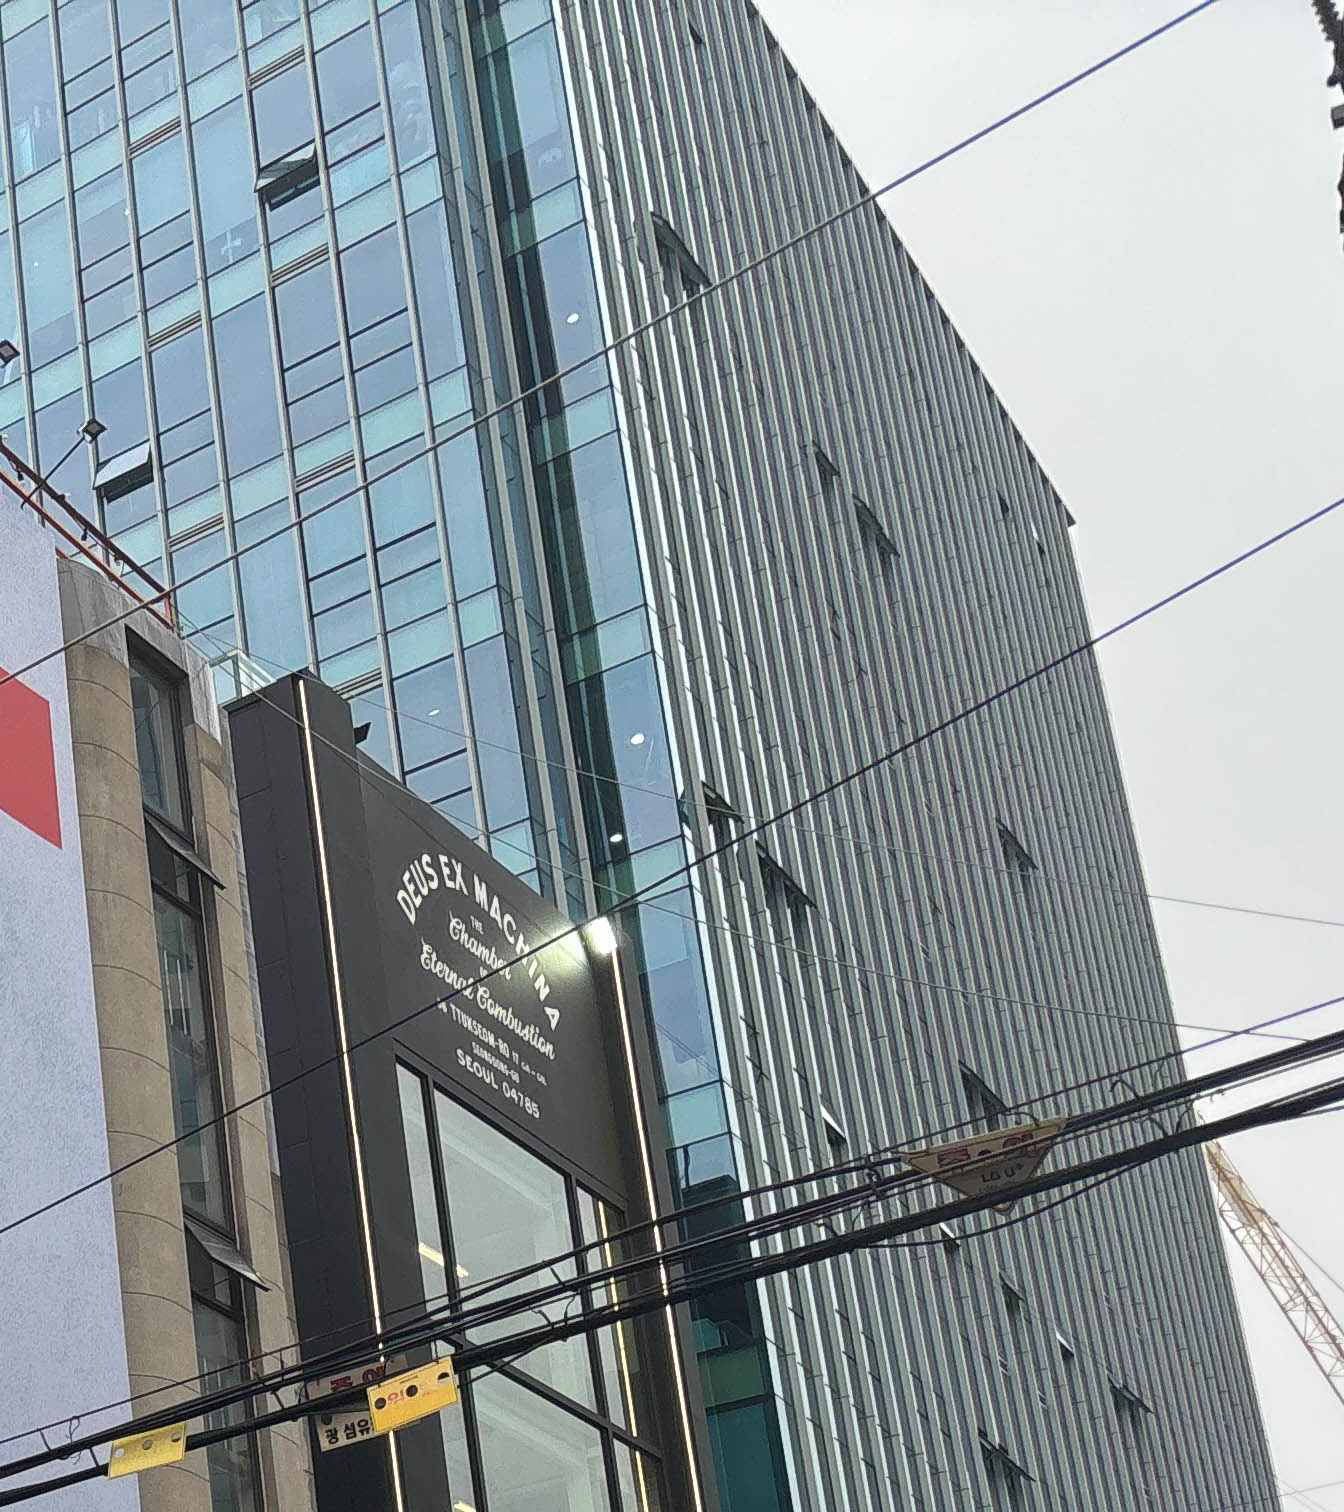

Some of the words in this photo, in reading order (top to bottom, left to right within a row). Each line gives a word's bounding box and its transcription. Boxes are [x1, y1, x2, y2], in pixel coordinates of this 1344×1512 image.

[396, 854, 438, 925] DEUS
[438, 854, 468, 896] EX
[473, 872, 561, 1031] MACHINA
[476, 983, 555, 1060] Combustion
[457, 1049, 499, 1089] SEOUL
[502, 1081, 540, 1118] 04785
